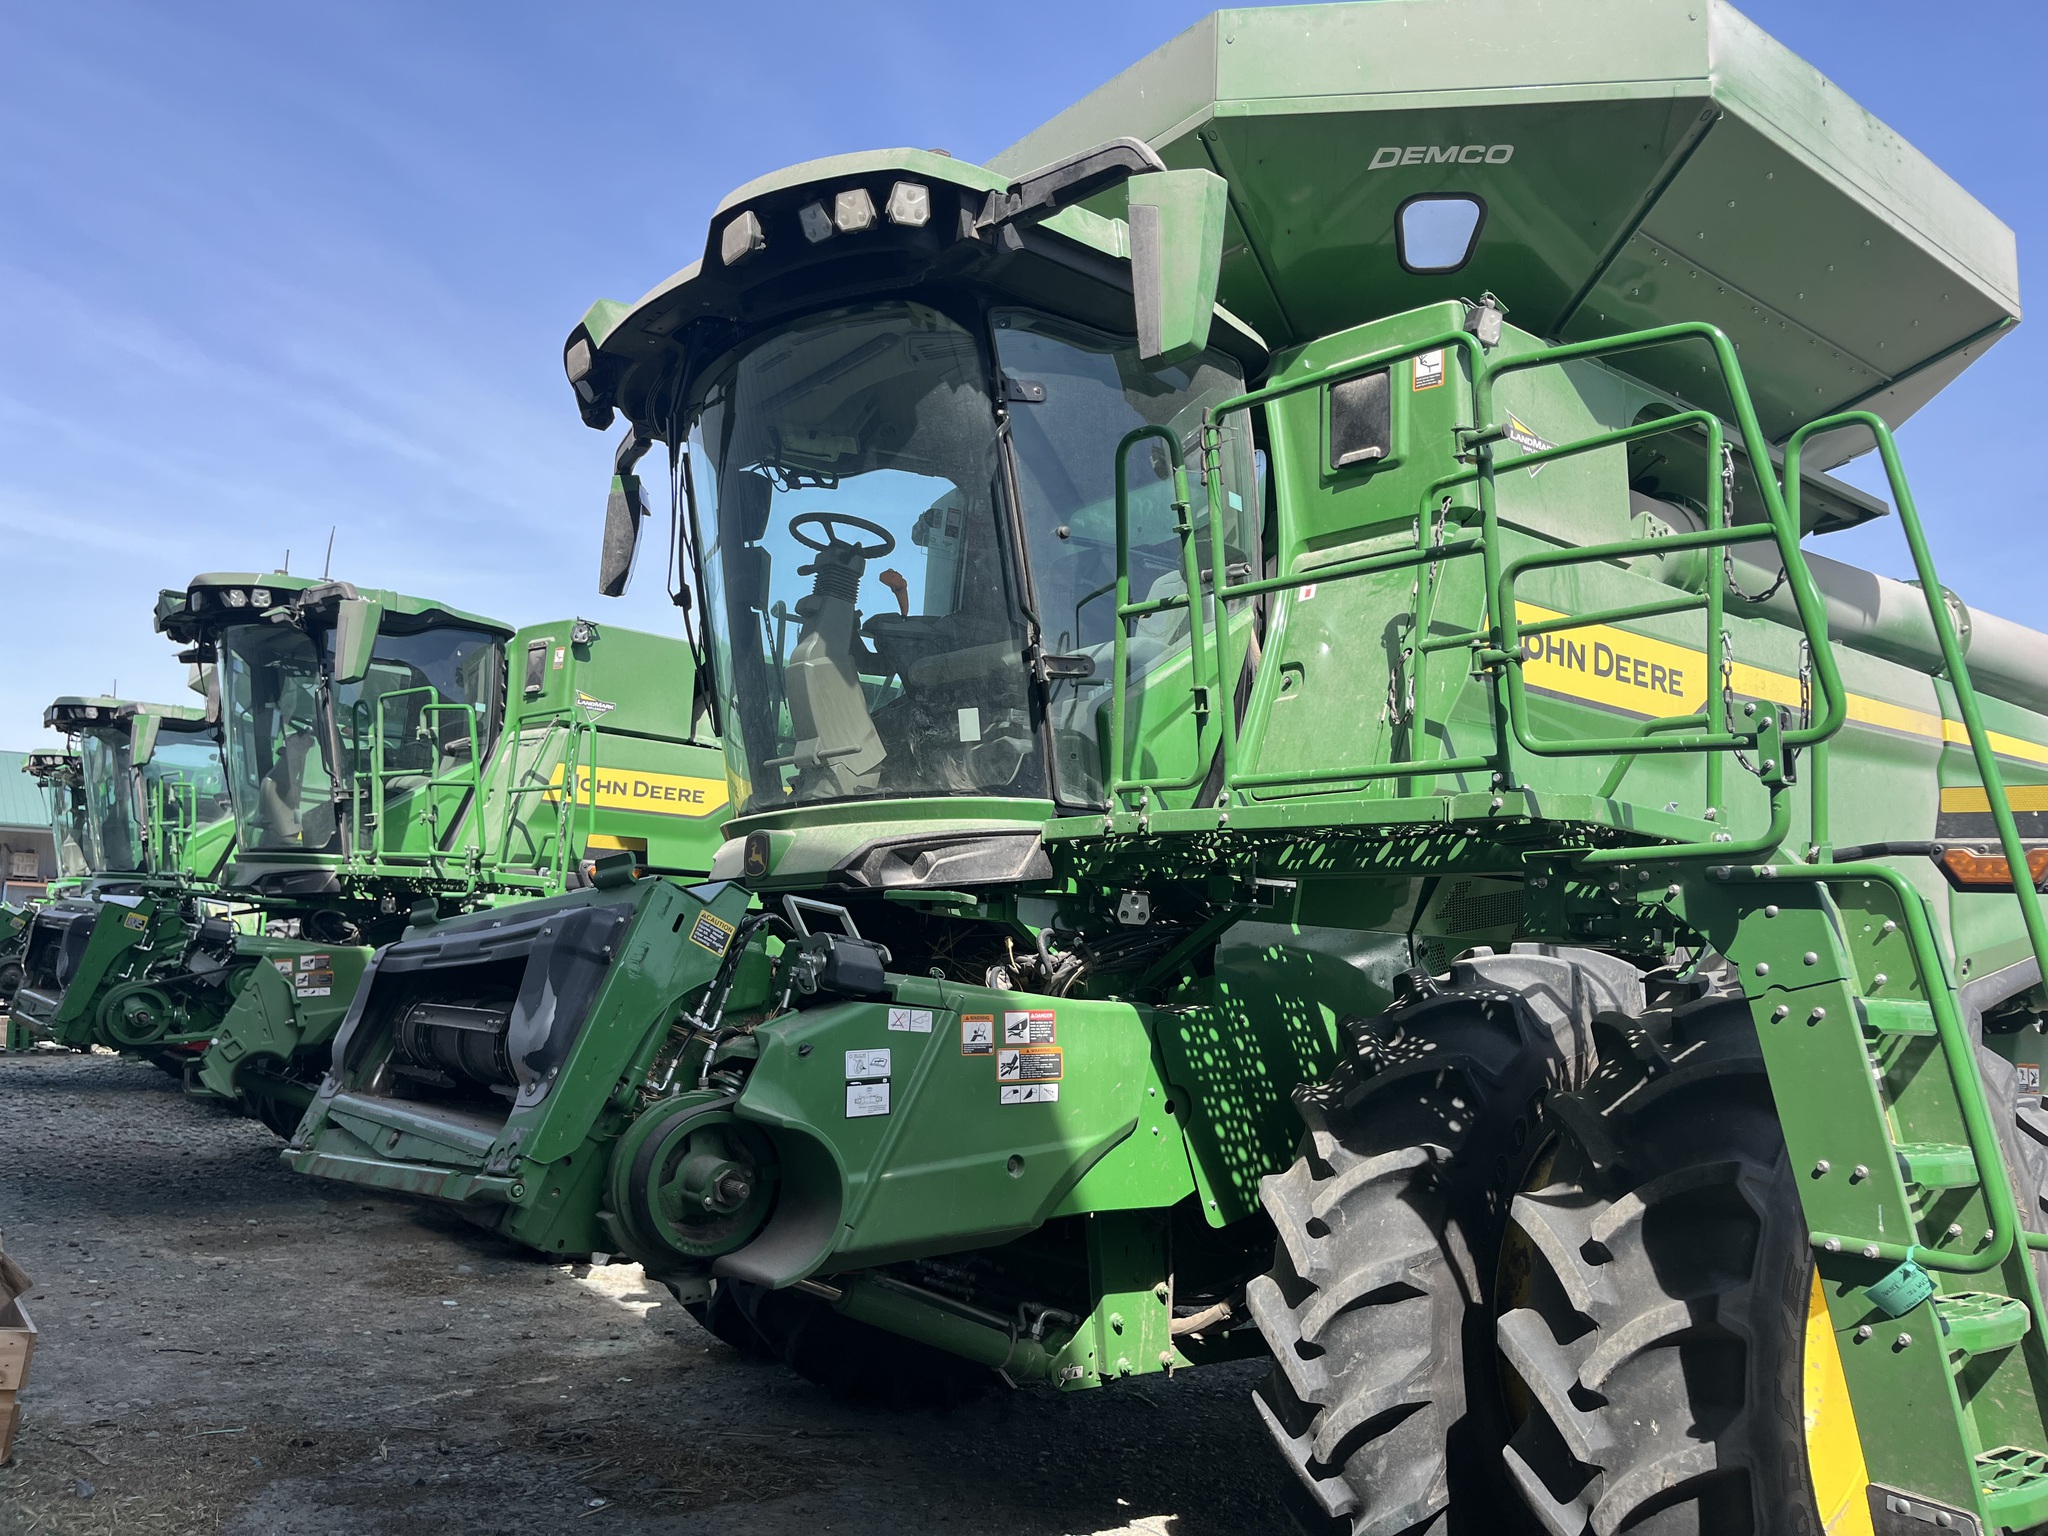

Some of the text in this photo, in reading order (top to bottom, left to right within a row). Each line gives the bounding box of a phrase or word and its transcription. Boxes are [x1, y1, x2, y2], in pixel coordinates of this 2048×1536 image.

[1367, 144, 1515, 171] DEMCO
[1510, 429, 1553, 451] LANDMA
[1594, 641, 1684, 698] DEERE
[634, 780, 705, 804] DEERE
[706, 914, 733, 933] CAUTION
